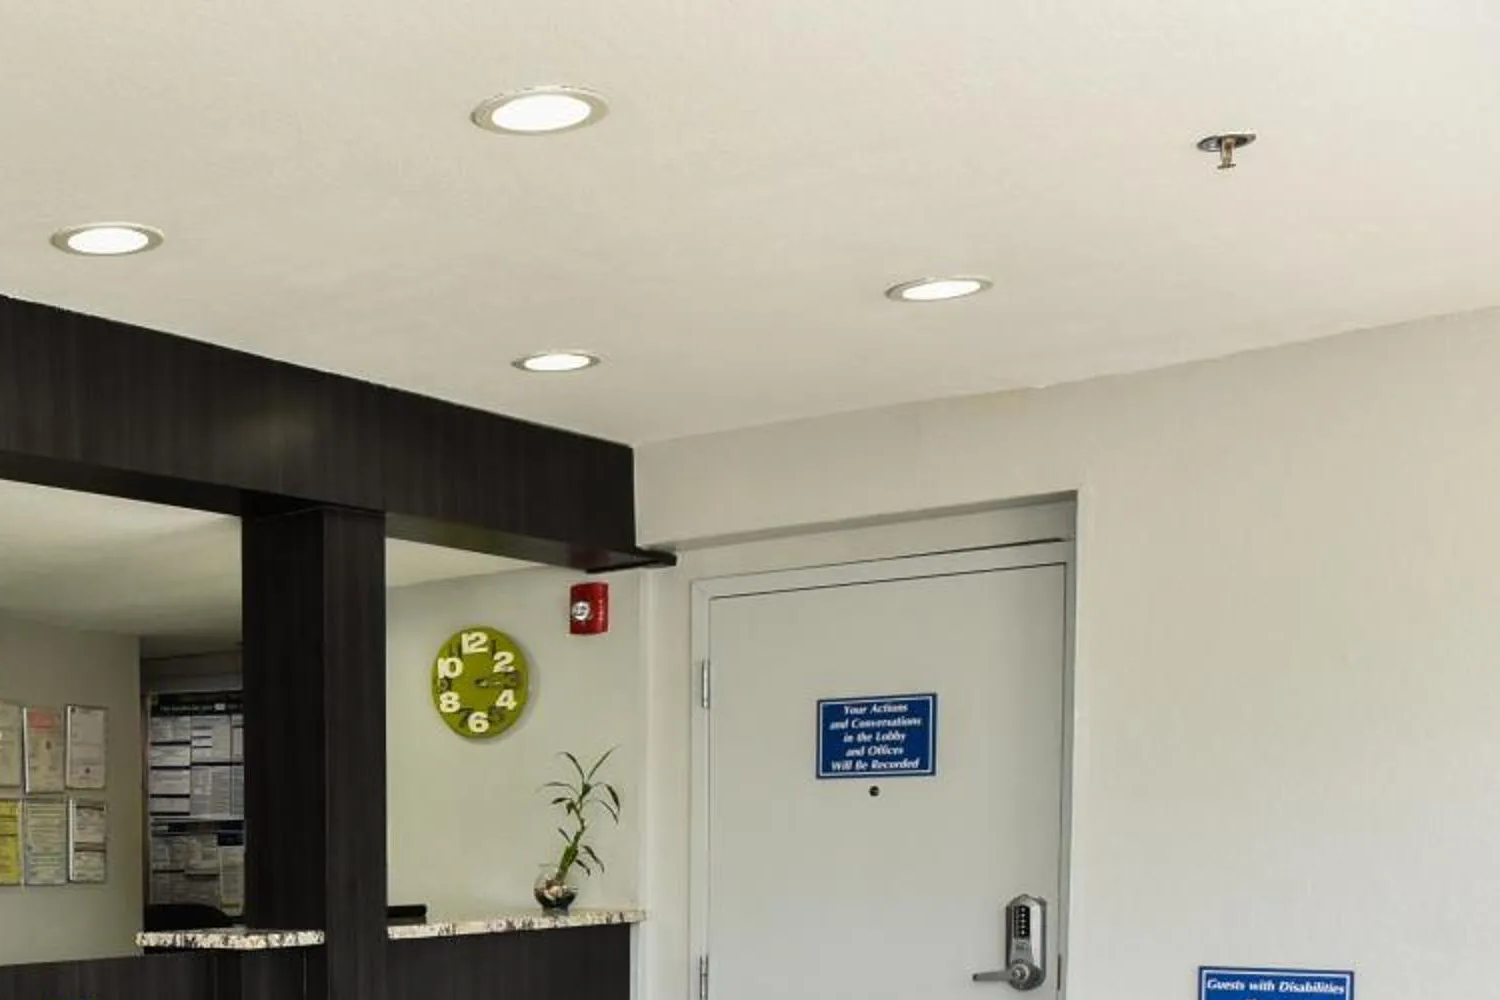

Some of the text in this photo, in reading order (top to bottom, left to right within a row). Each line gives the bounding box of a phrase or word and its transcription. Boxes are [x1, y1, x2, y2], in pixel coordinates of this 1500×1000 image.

[461, 632, 489, 654] 12
[437, 656, 463, 679] 10
[493, 651, 515, 673] 2
[439, 690, 461, 713] 8
[496, 689, 517, 710] 4
[844, 703, 908, 715] Your Actions
[467, 711, 490, 733] 6
[829, 716, 921, 730] and Conversations
[843, 730, 906, 743] in the Lobby
[845, 744, 904, 757] and Offices
[831, 758, 920, 771] Will Be Recorded
[1207, 978, 1344, 995] Guests with Disabilities
